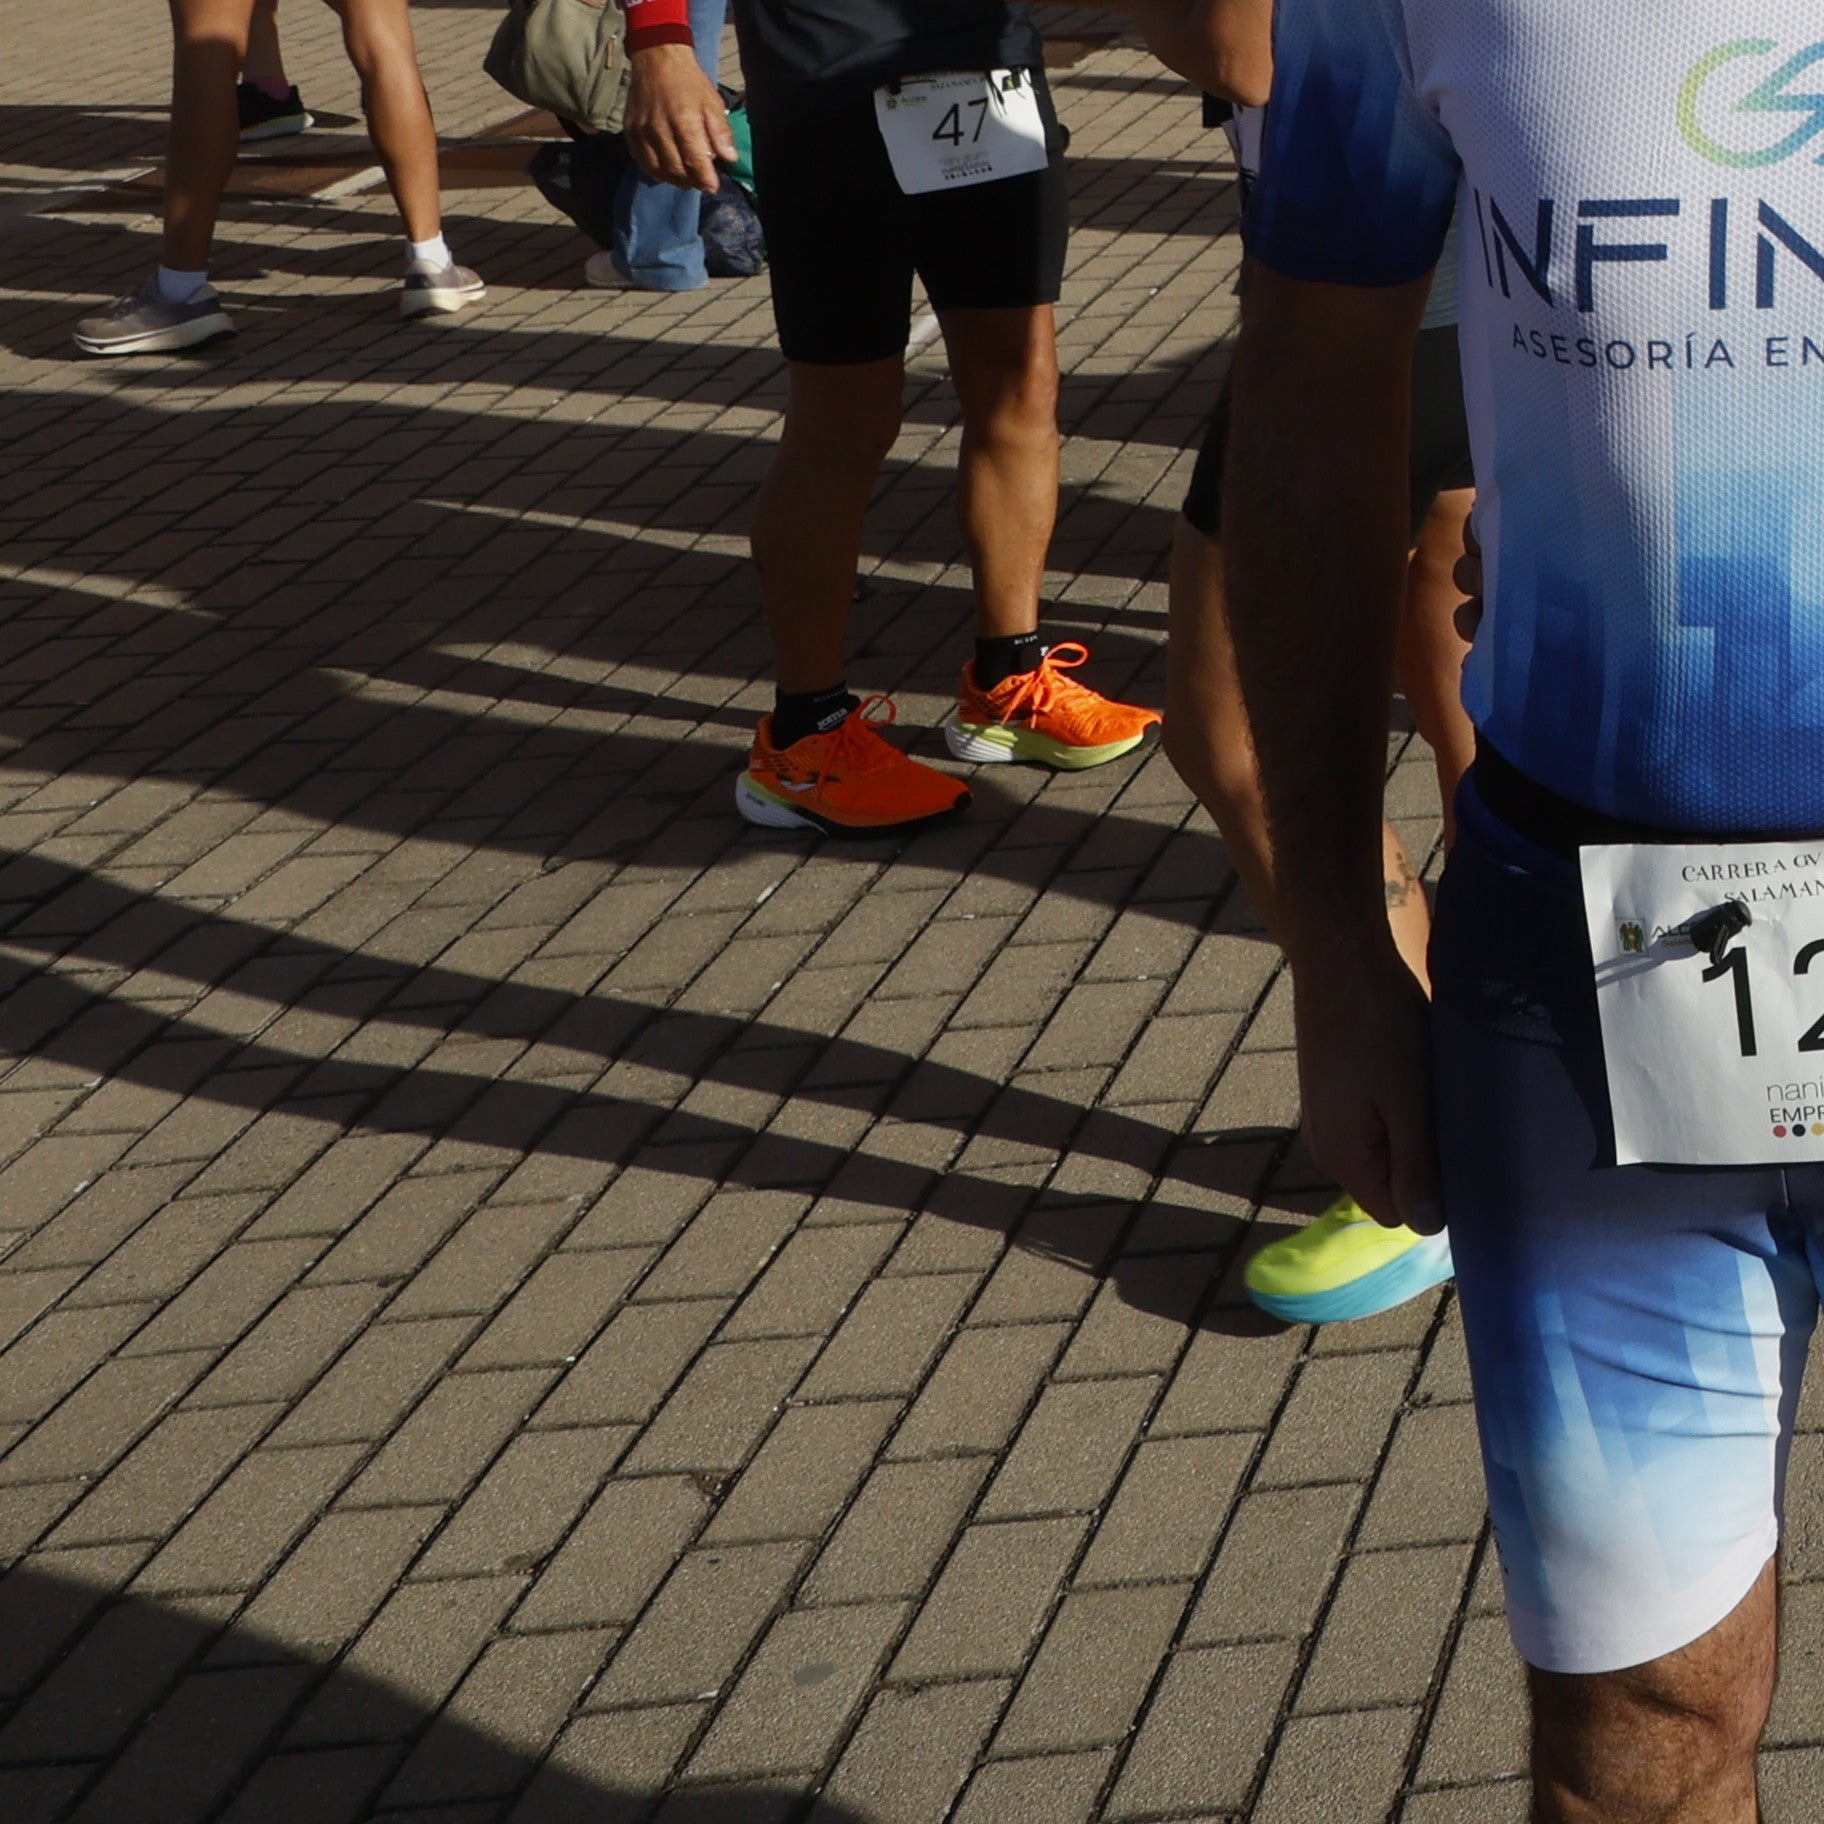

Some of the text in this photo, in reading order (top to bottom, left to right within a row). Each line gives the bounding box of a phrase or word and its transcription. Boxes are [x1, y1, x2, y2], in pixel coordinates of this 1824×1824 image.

[932, 97, 989, 146] 47
[1511, 322, 1735, 372] ASESORÍA
[1681, 857, 1785, 884] CARRERA
